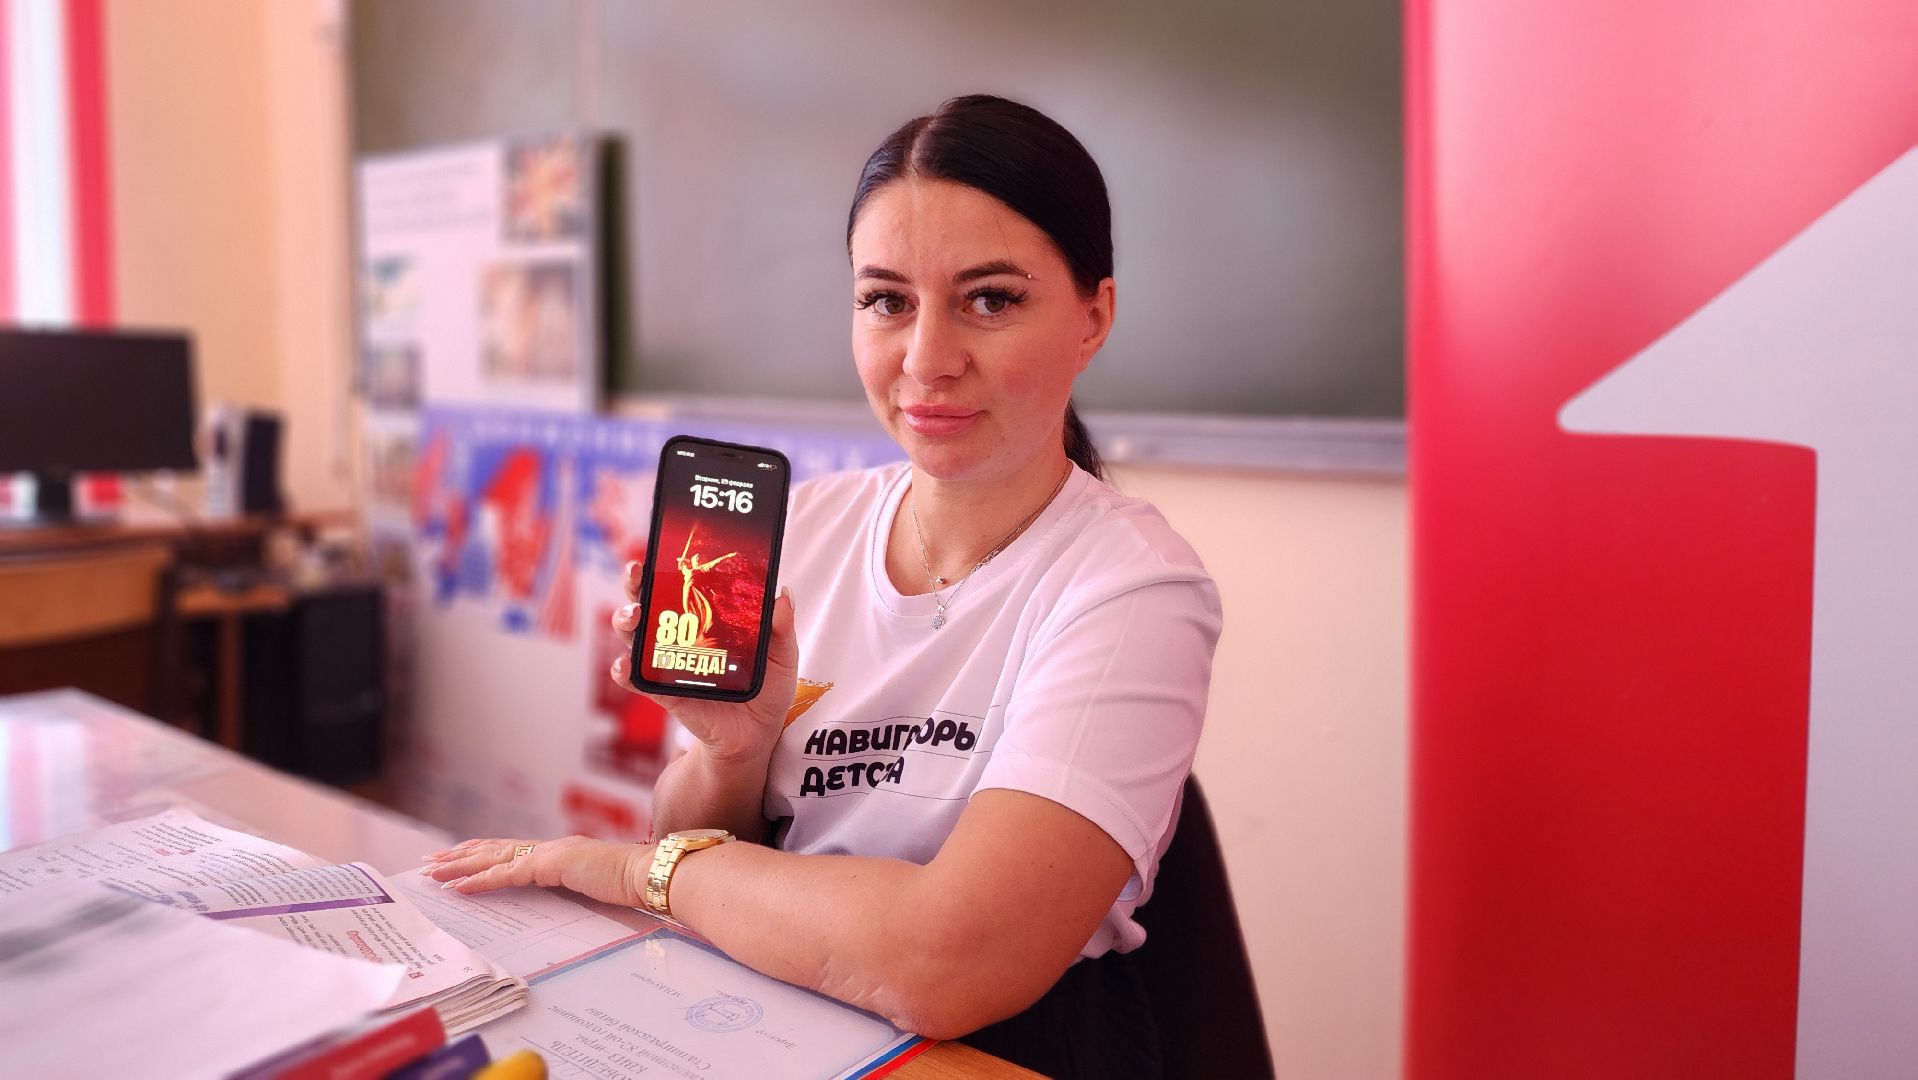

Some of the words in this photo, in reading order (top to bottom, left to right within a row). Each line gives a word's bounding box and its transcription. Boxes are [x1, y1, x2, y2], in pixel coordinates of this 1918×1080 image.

[690, 484, 754, 514] 15:16
[656, 610, 699, 647] 80
[652, 649, 727, 676] ПОБЕДА!
[552, 1040, 634, 1080] ОБЕДИТЕЛЬ
